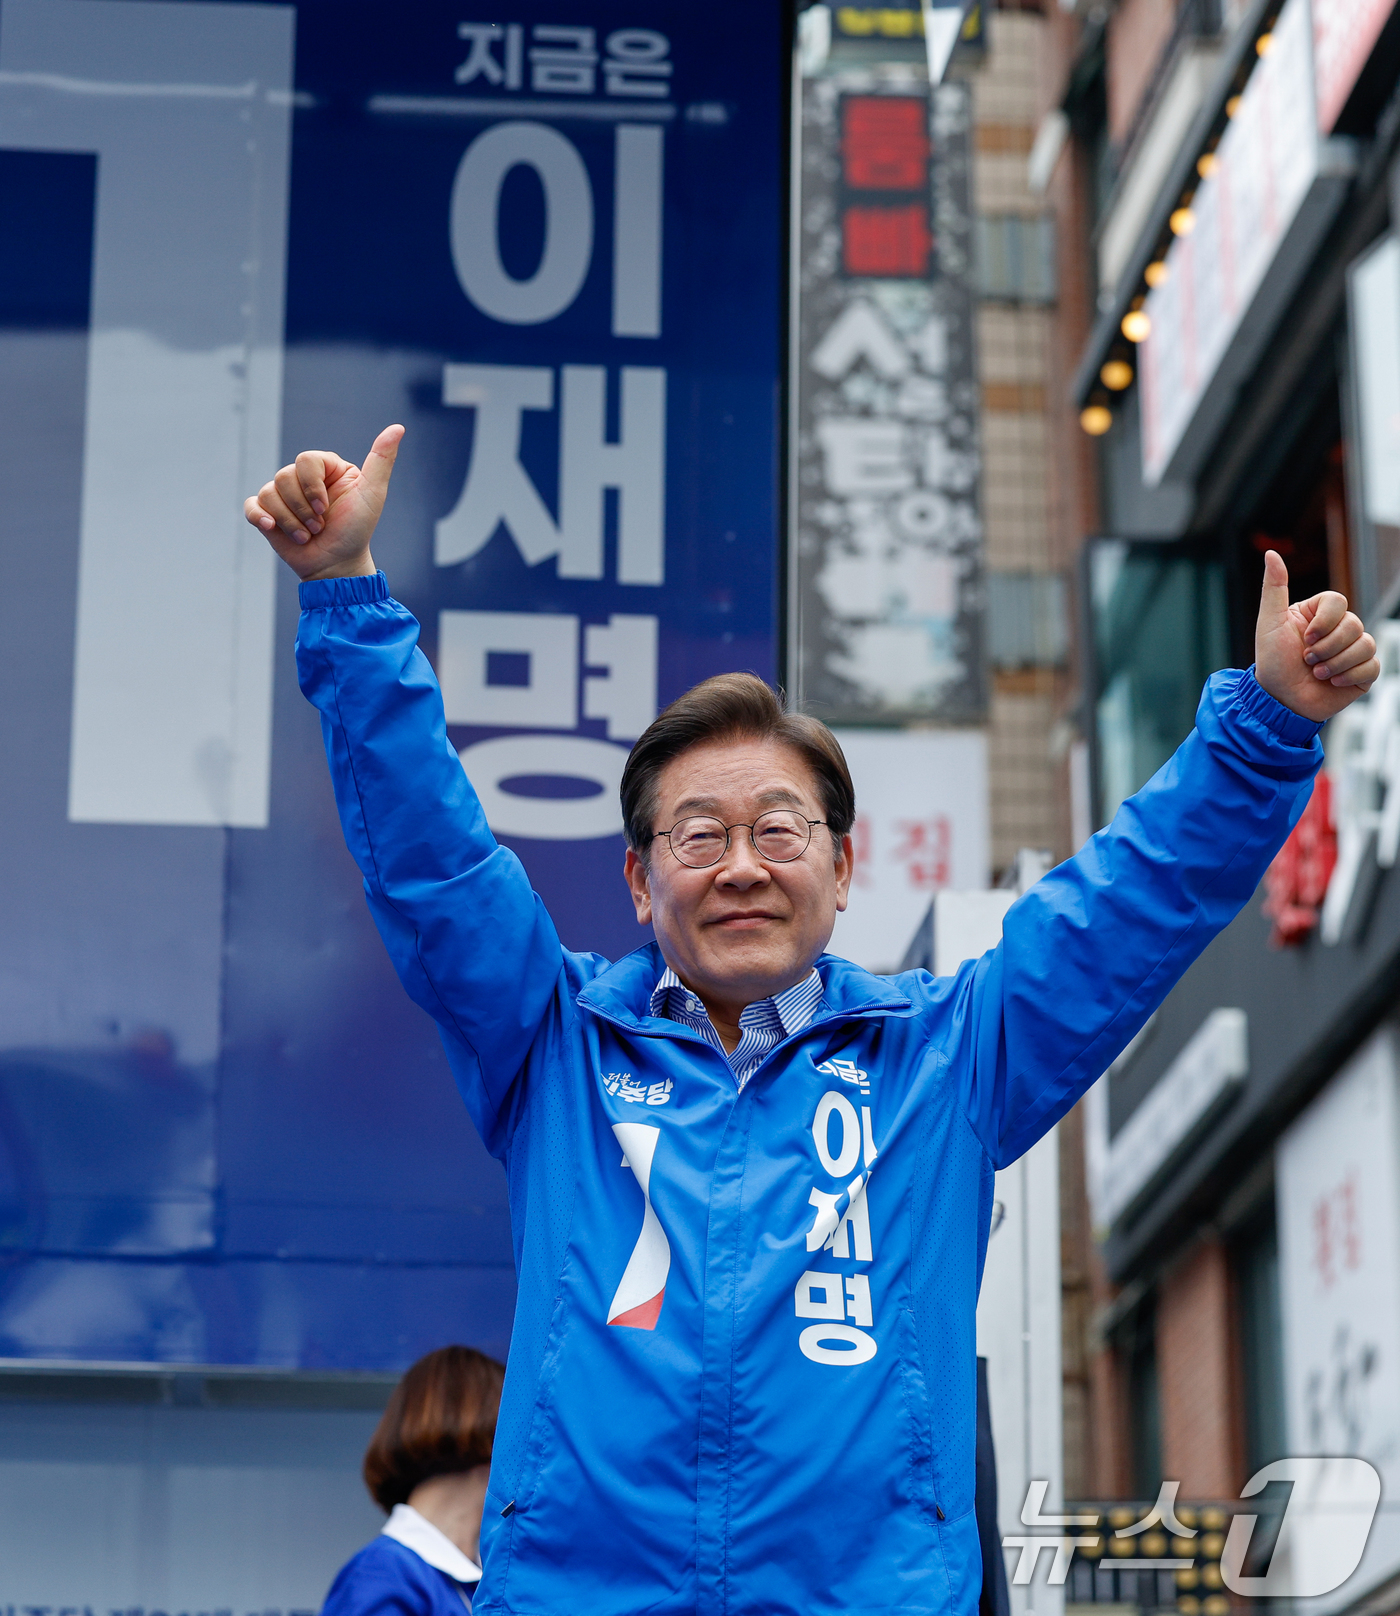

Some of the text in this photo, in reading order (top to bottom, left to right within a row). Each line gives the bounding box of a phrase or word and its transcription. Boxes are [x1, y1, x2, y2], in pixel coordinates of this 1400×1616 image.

[455, 22, 673, 98] 지금은
[433, 121, 667, 841] 이재명
[608, 1072, 641, 1089] 더불어
[794, 1090, 878, 1367] 이재명
